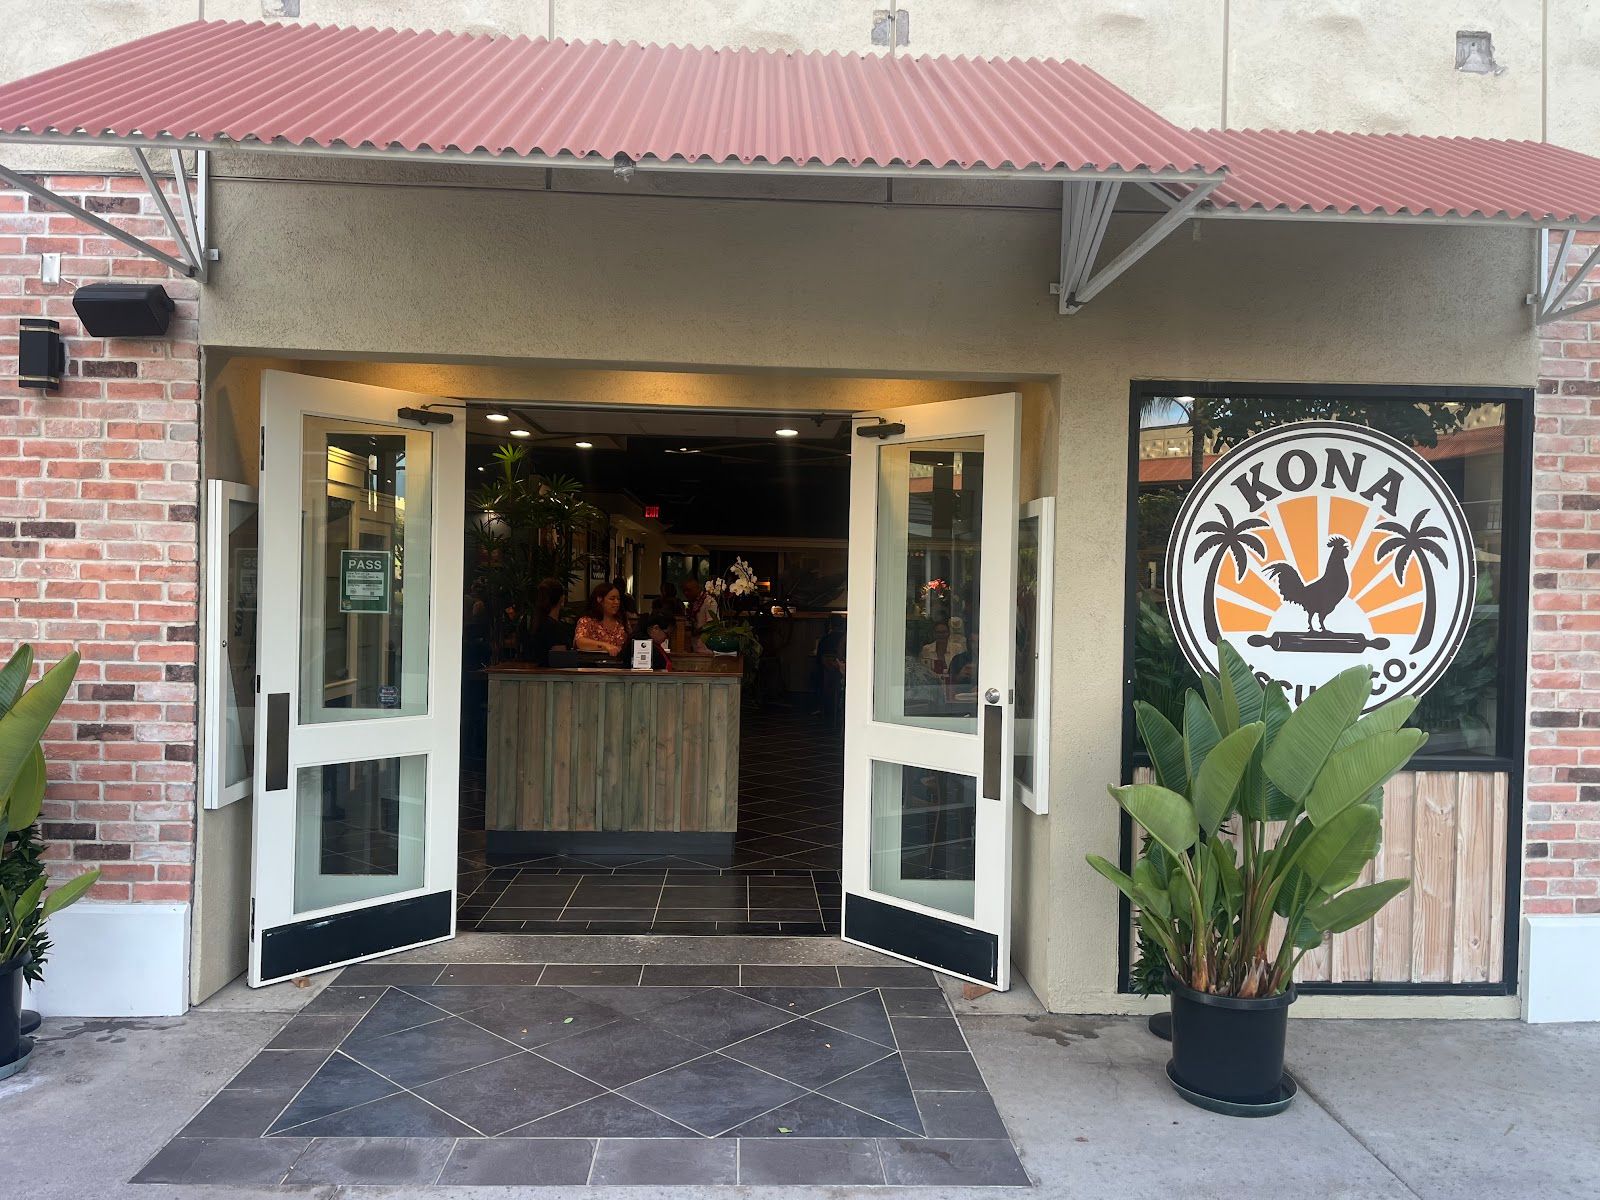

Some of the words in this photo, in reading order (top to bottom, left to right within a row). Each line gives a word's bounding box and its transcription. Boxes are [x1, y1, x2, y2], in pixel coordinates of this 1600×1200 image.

[1231, 448, 1404, 517] KONA
[645, 506, 659, 518] EXIT
[348, 559, 382, 570] PASS
